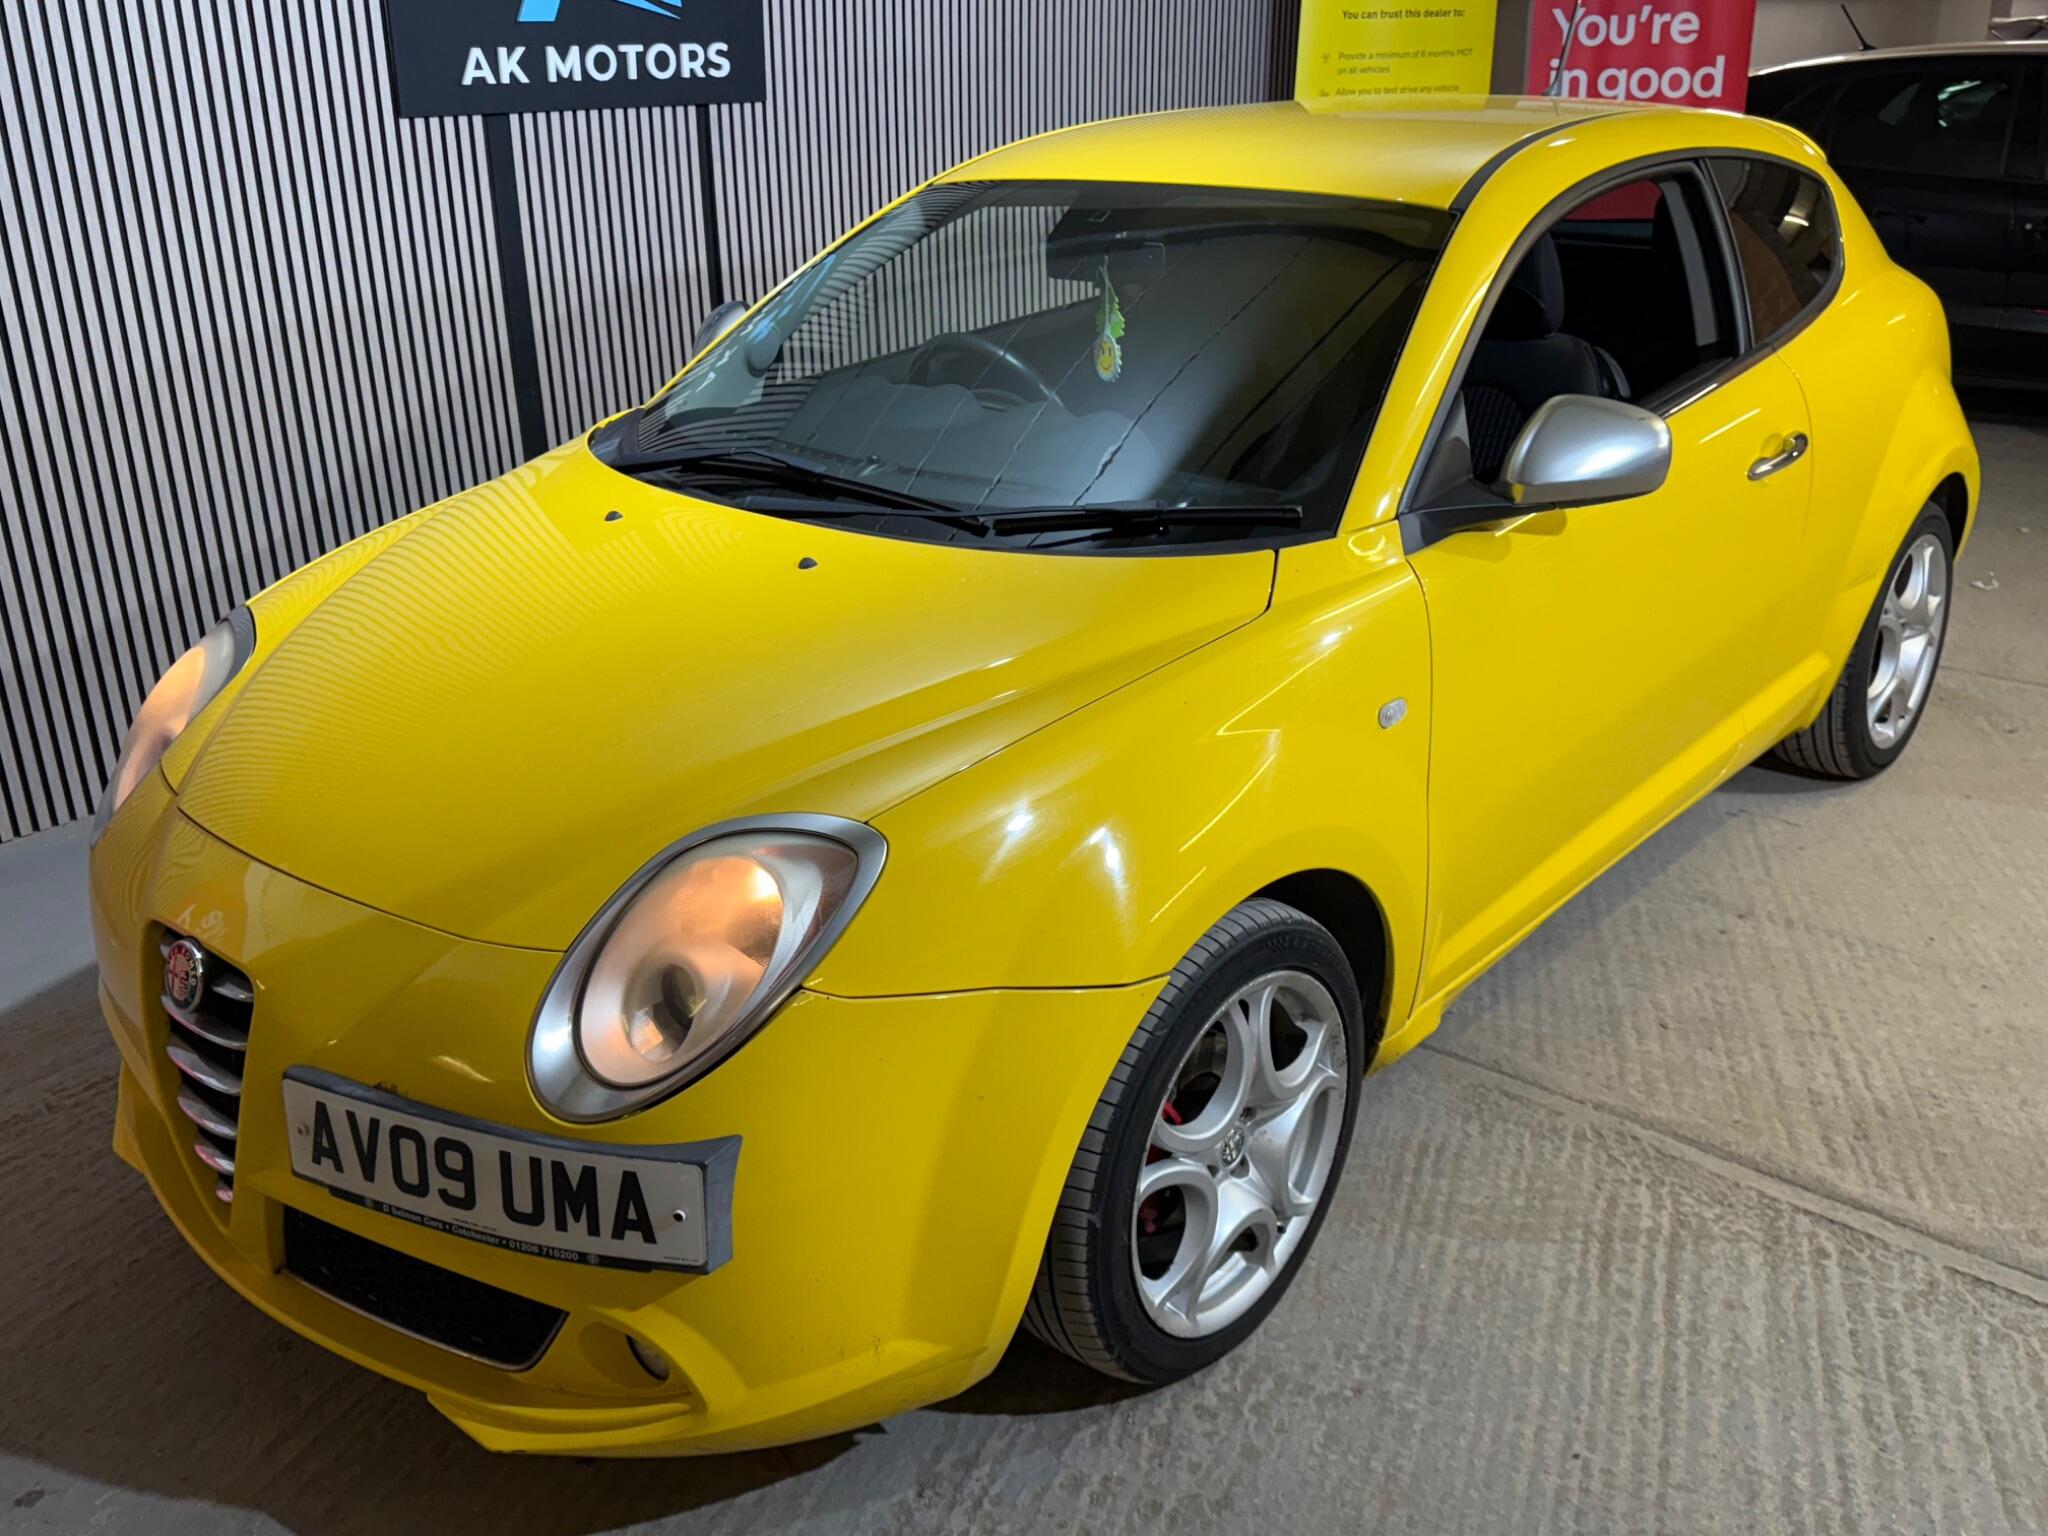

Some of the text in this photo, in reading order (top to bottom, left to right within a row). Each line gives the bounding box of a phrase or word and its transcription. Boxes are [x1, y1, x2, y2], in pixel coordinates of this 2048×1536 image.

[1342, 8, 1466, 19] You can trust this dealer to:
[1552, 5, 1700, 47] You're
[462, 42, 731, 85] AK MOTORS
[1338, 52, 1366, 61] Provide
[1376, 51, 1410, 59] minimum
[1421, 50, 1426, 58] 6
[1427, 50, 1455, 58] months
[1456, 48, 1473, 57] MOT
[1348, 66, 1357, 74] all
[1359, 66, 1390, 74] vehicles
[1597, 55, 1726, 100] good
[1336, 84, 1459, 97] Allow you to test drive any vehicle
[312, 1100, 657, 1244] AV09 UMA
[424, 1216, 443, 1230] Cars
[452, 1225, 500, 1246] Colchester
